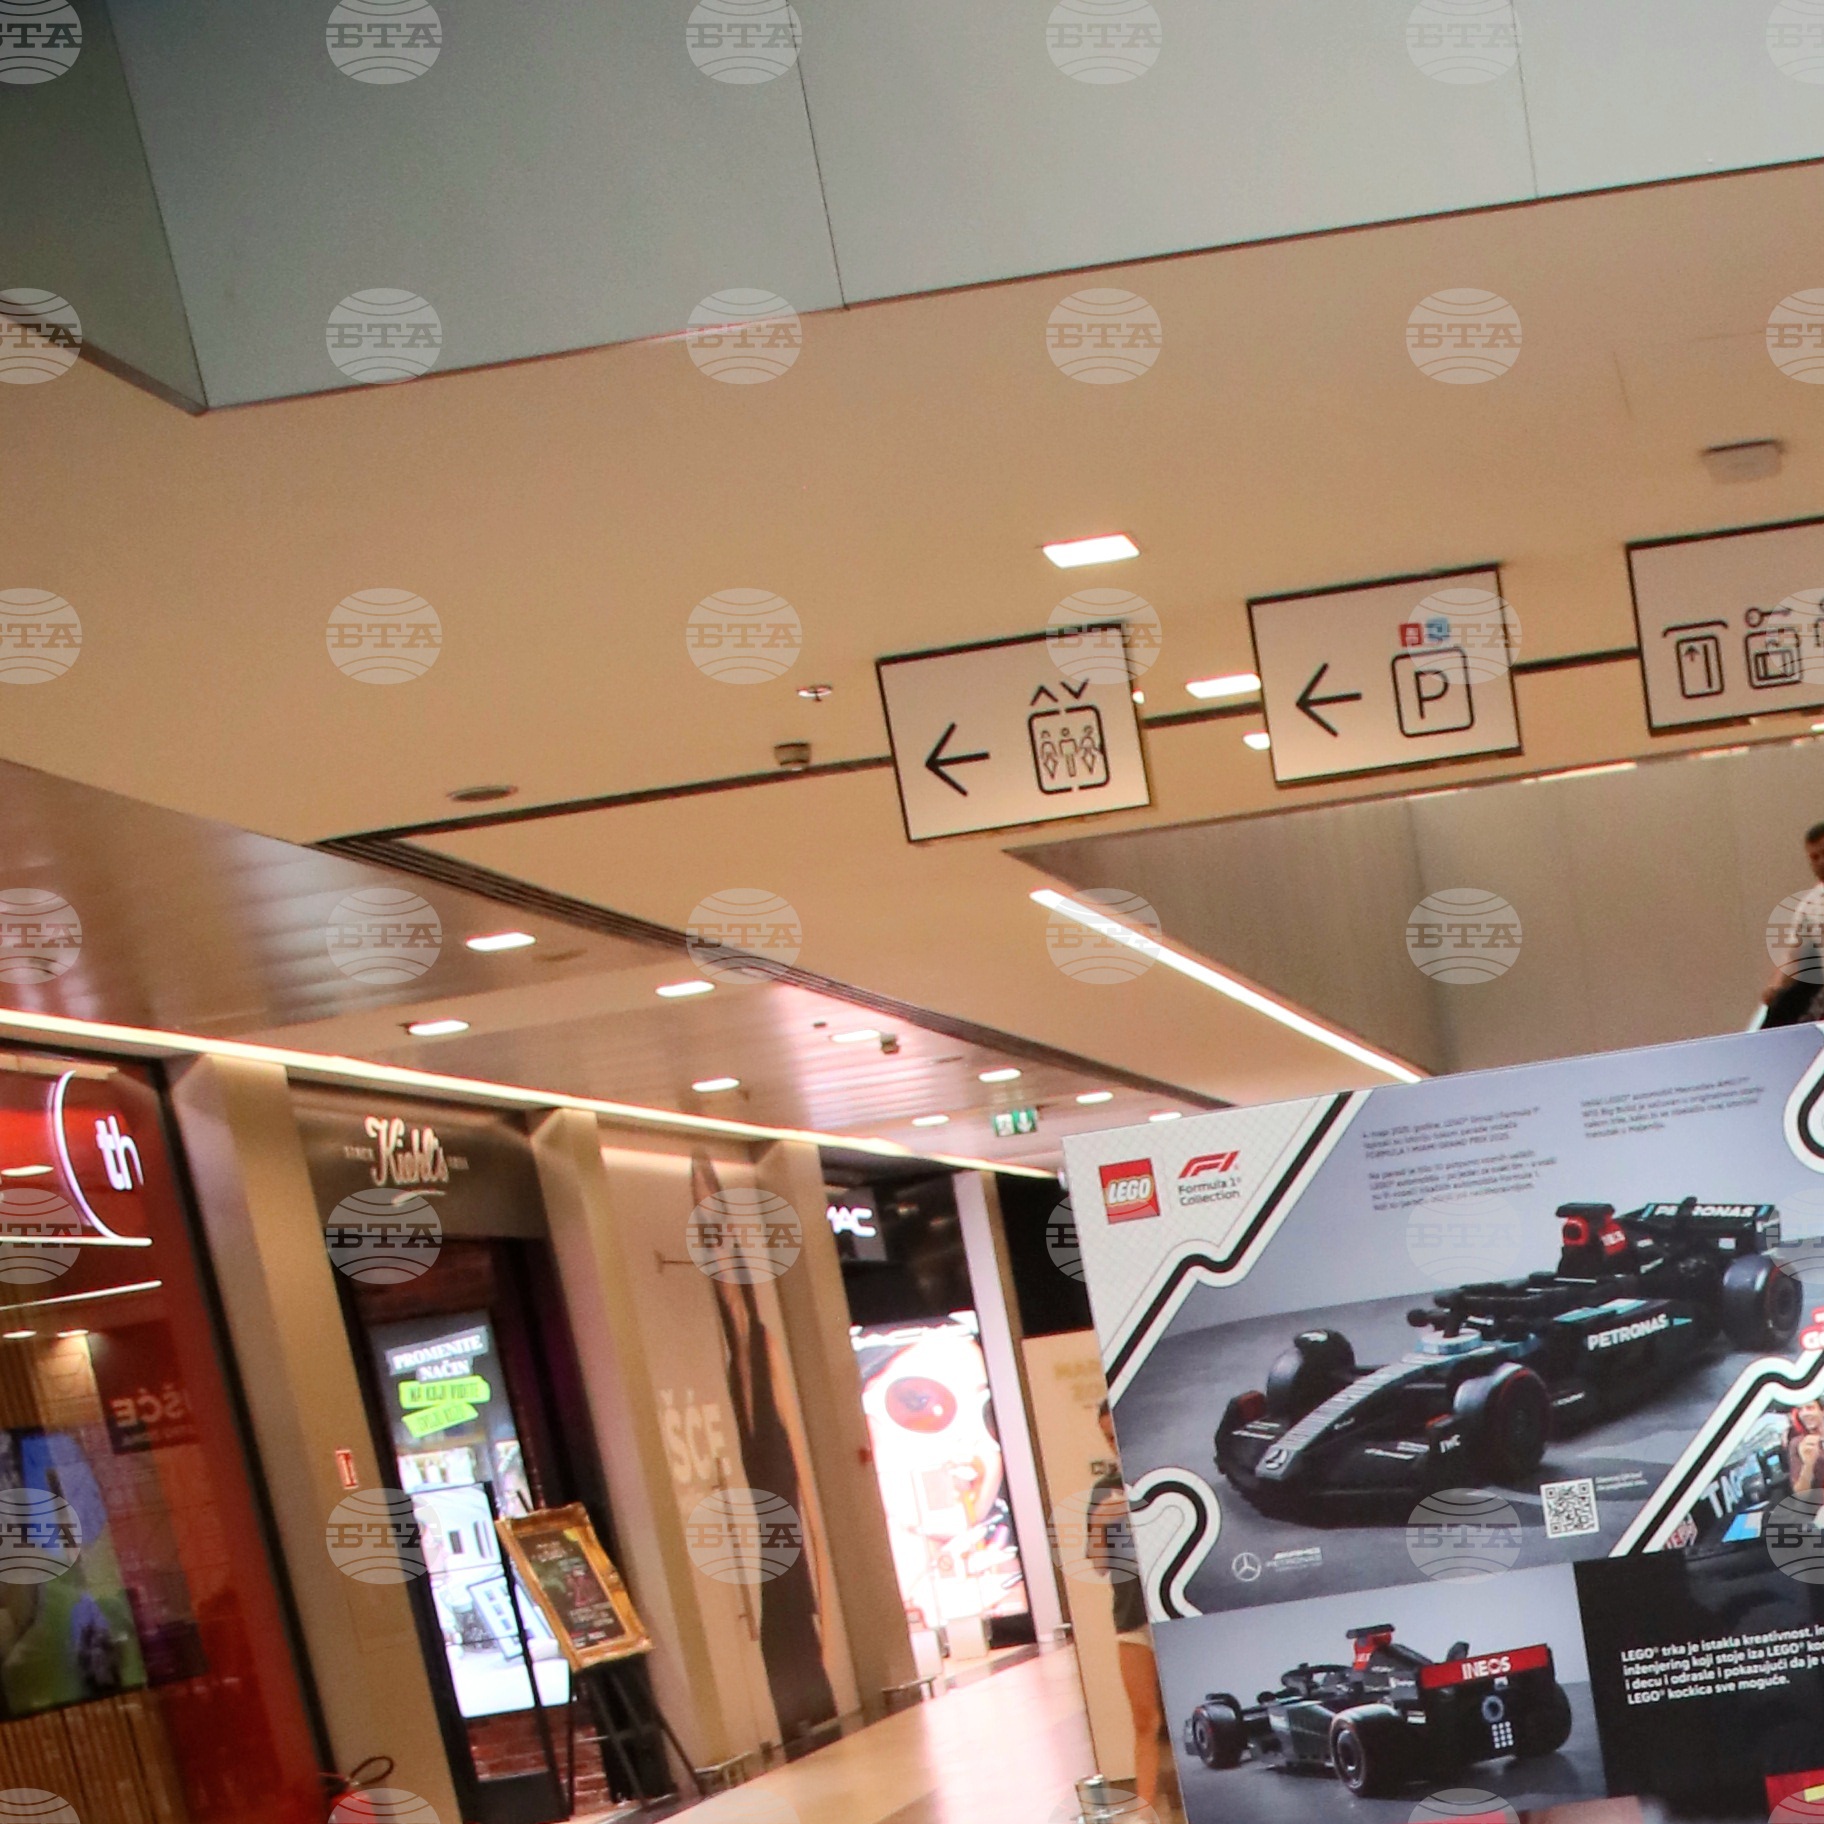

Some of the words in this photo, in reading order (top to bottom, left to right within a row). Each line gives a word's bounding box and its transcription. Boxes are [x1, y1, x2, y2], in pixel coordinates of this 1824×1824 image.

[1414, 669, 1448, 719] P
[1109, 1177, 1152, 1205] LEGO
[1180, 1190, 1240, 1206] Collection
[1588, 1314, 1670, 1351] PETRONAS
[1687, 1642, 1699, 1656] je
[1462, 1656, 1511, 1680] INEOS
